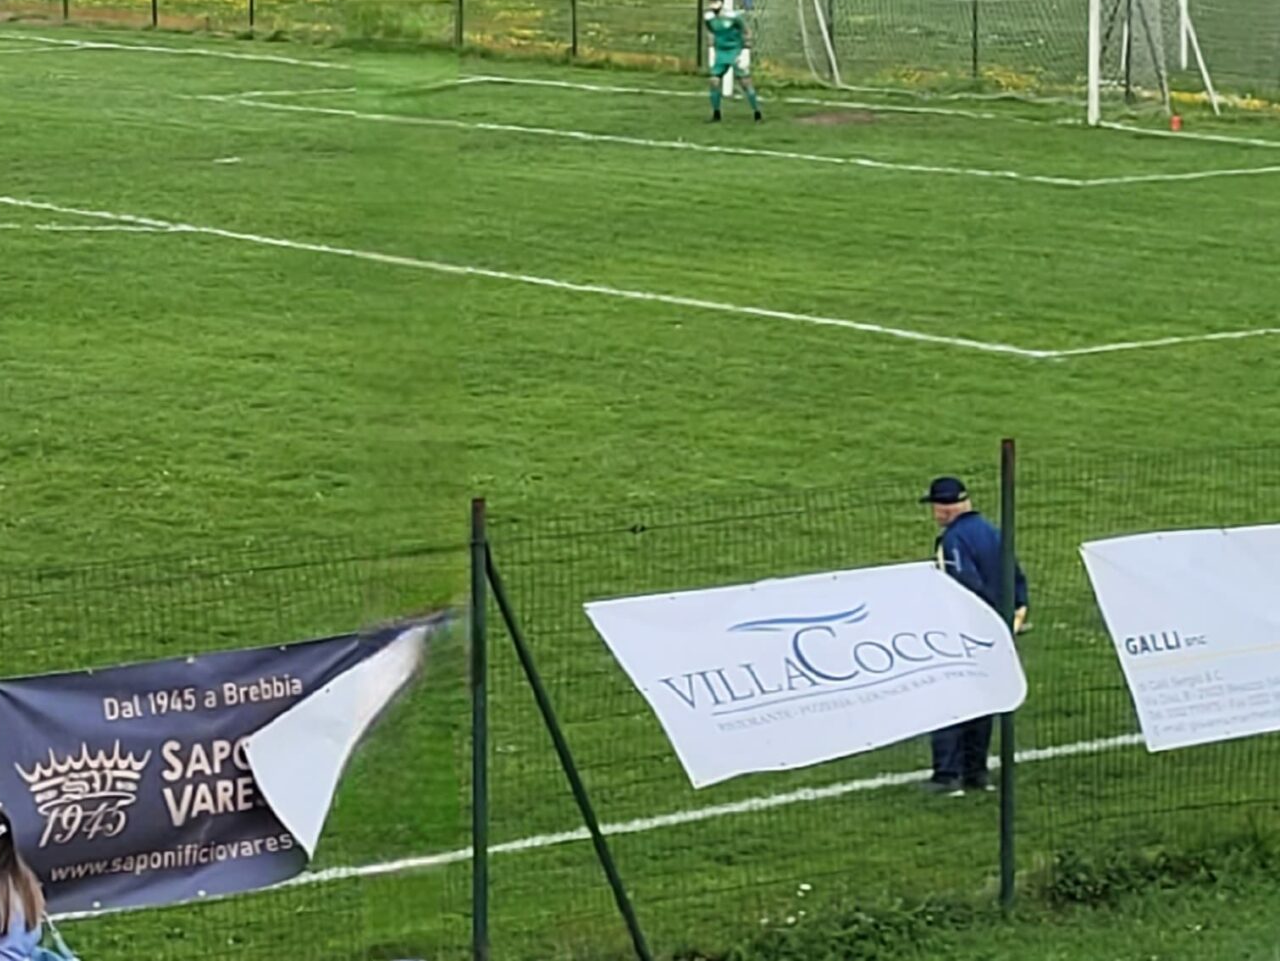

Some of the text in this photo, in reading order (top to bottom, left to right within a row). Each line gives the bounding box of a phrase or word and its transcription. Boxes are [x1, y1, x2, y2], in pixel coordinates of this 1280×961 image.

[1125, 630, 1181, 655] GALLI
[103, 674, 303, 721] Dal 1945 a Brebbia
[39, 802, 126, 848] 1945
[162, 777, 266, 827] VARE
